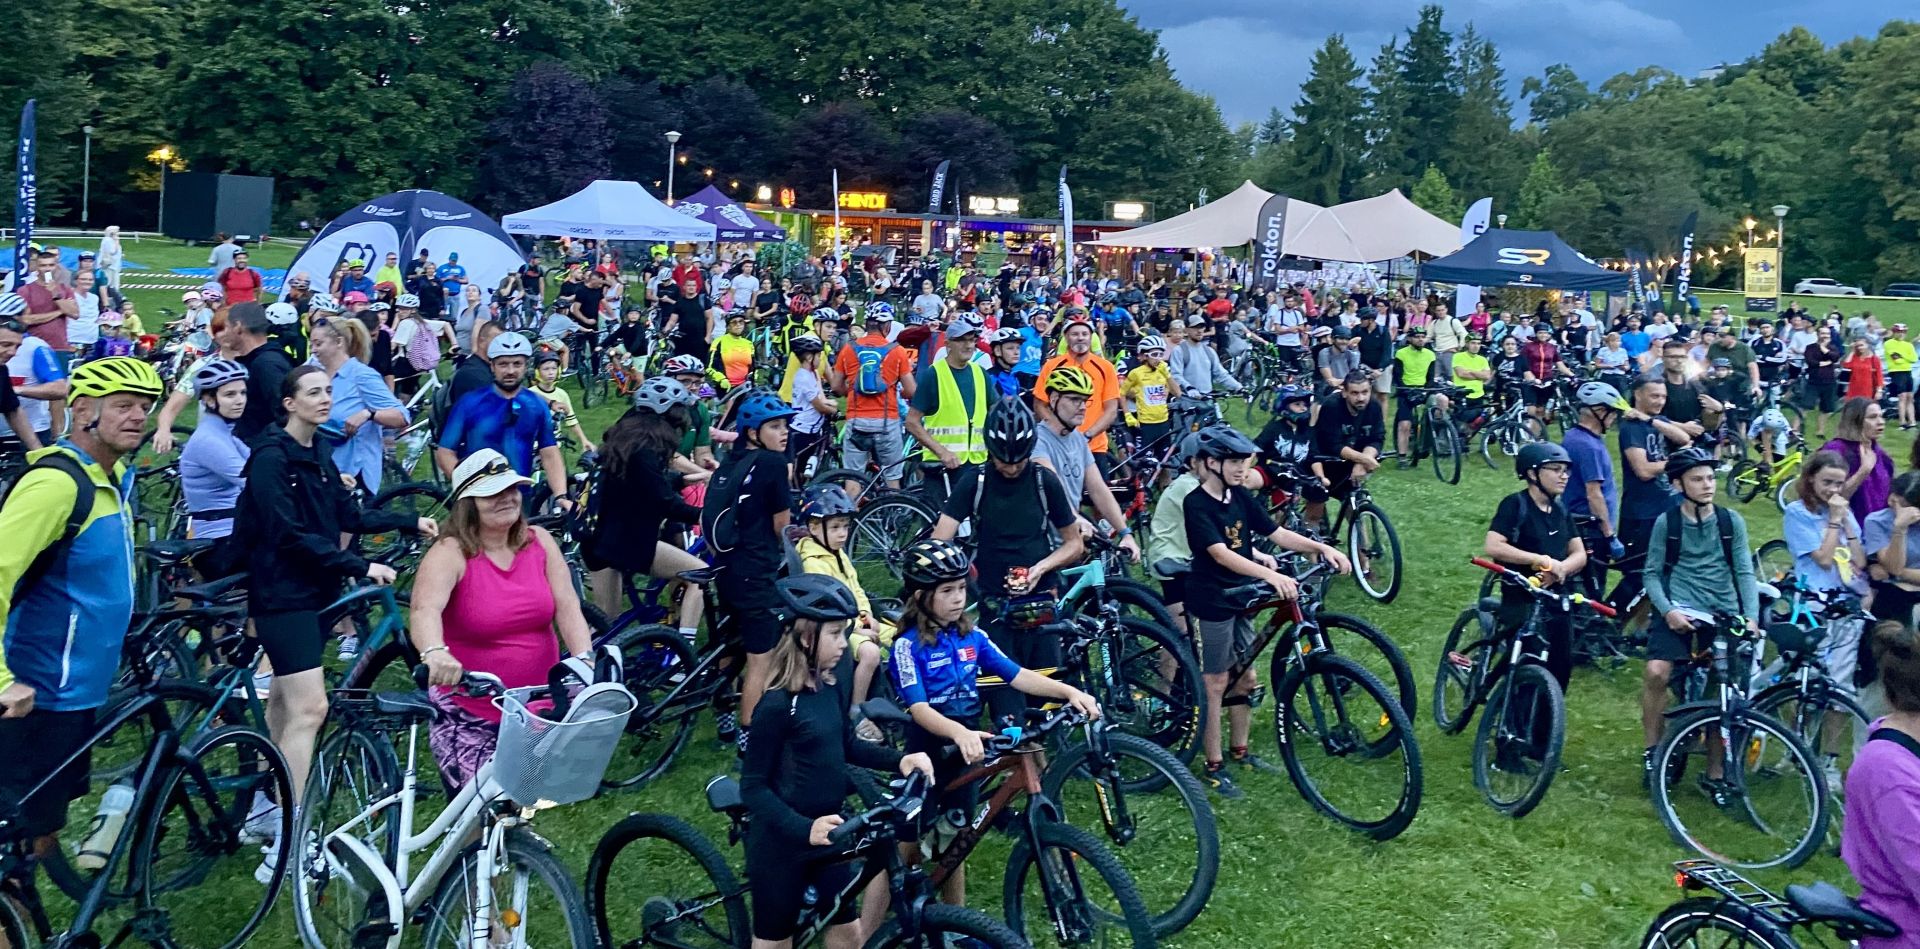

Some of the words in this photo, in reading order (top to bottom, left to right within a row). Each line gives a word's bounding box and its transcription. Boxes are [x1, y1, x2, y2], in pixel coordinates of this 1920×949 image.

[932, 172, 944, 189] JACK
[930, 189, 940, 207] LORD
[1260, 212, 1282, 278] rokton.
[1496, 247, 1551, 266] SR
[1677, 233, 1694, 302] rokton.
[1147, 386, 1165, 395] UAE
[1278, 702, 1288, 744] MAXXIS
